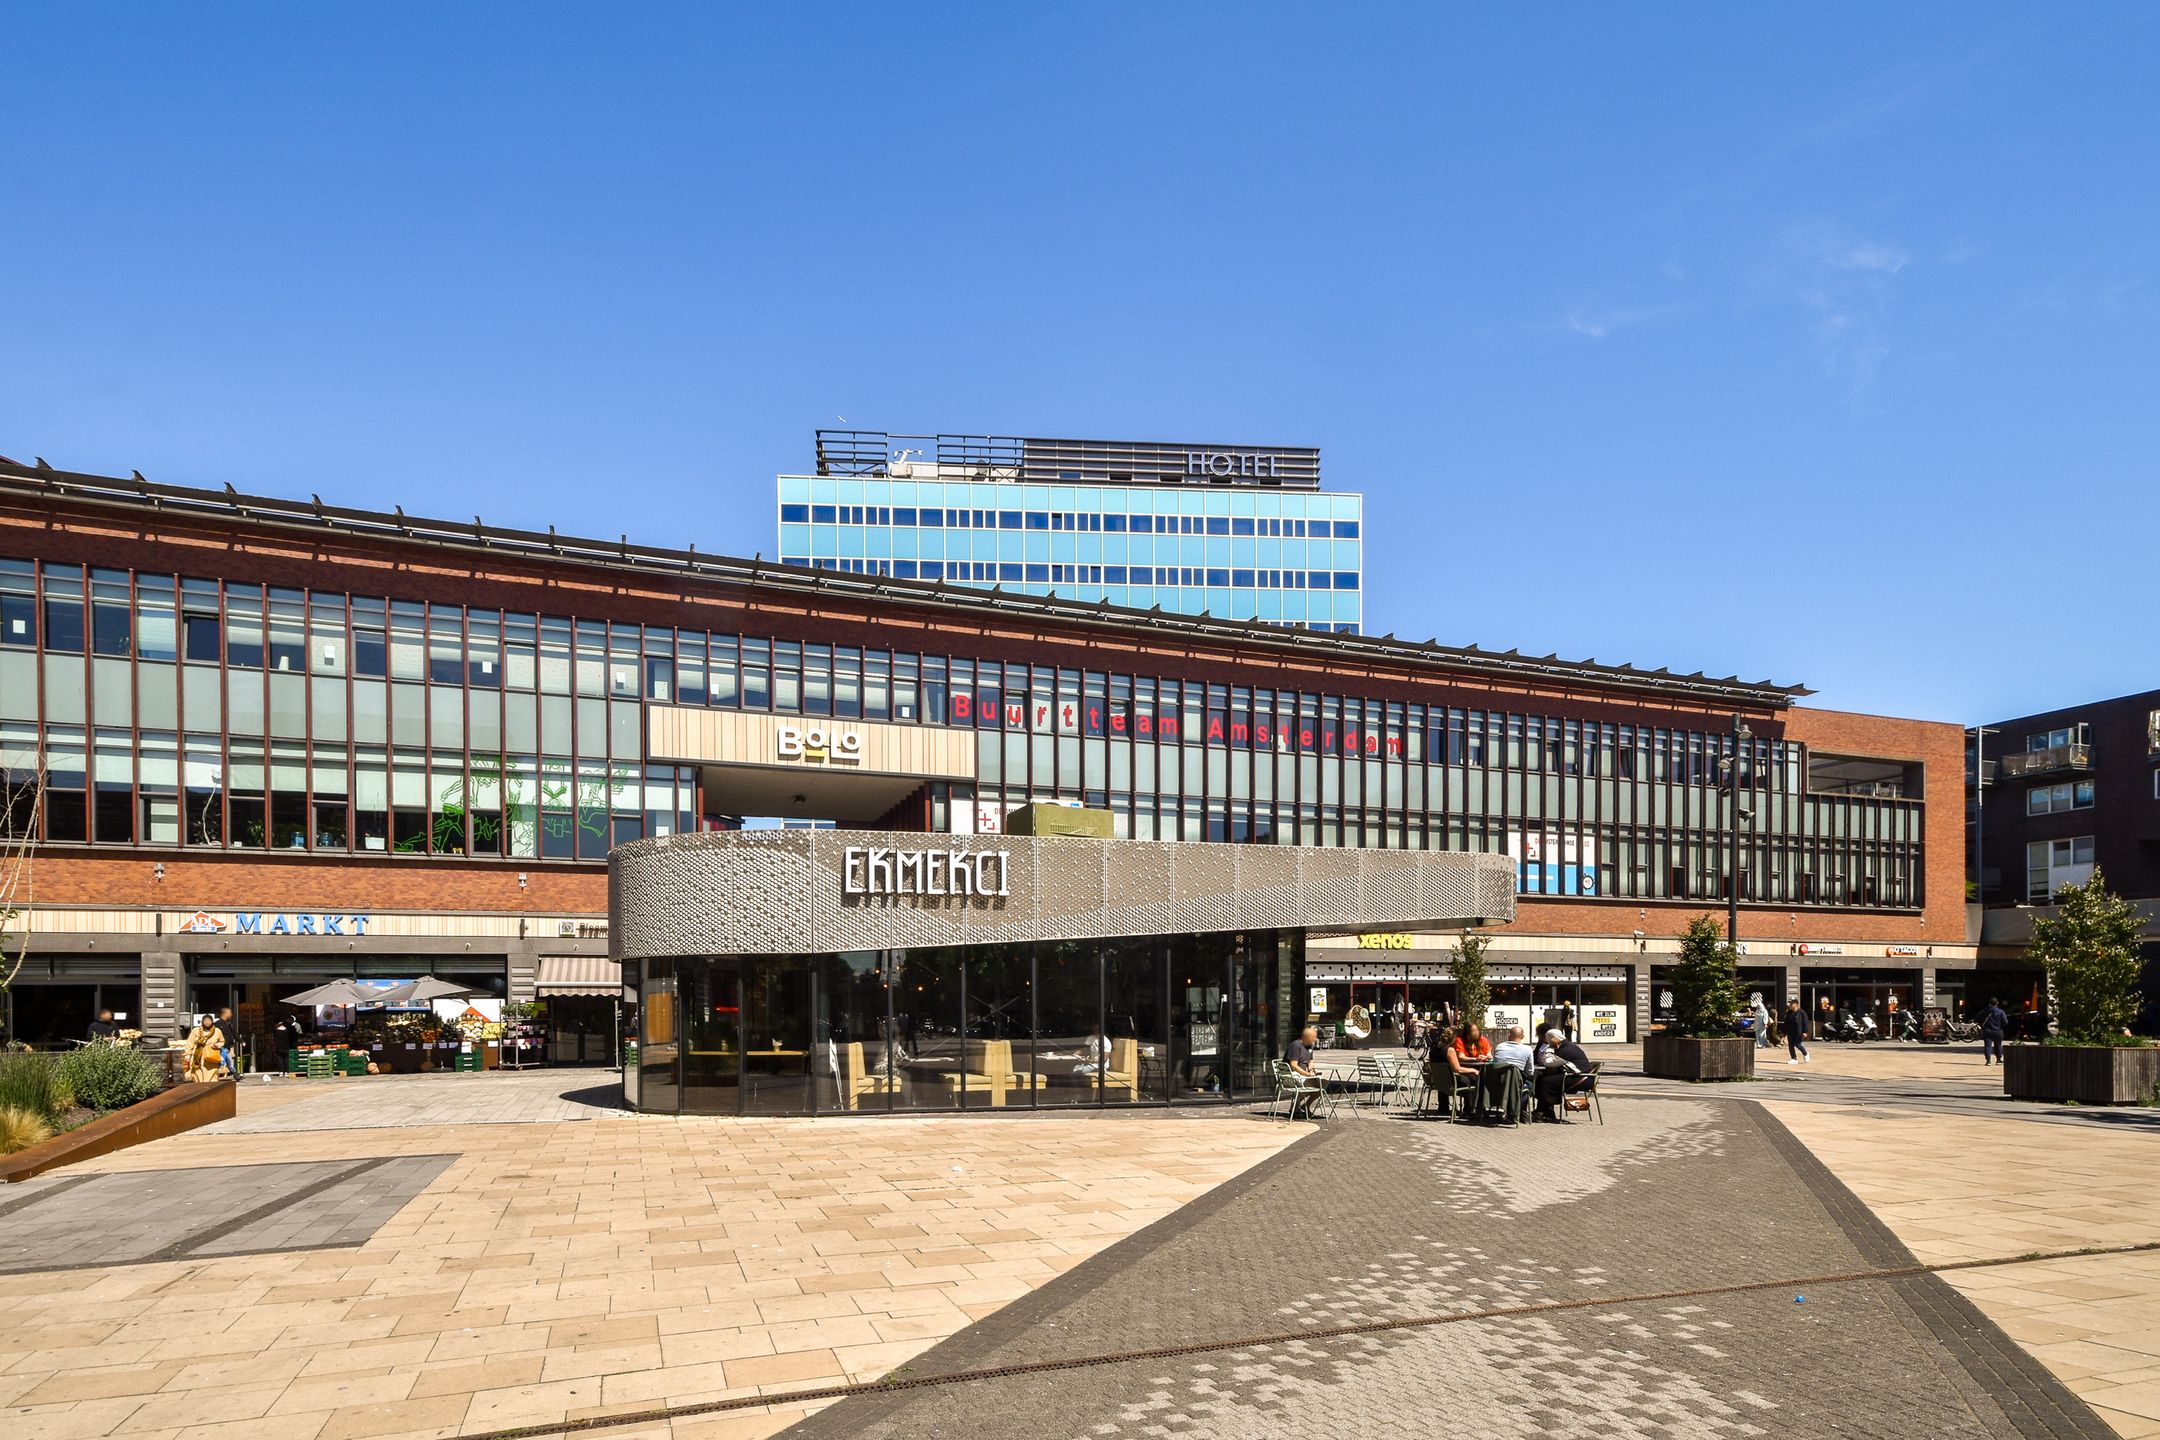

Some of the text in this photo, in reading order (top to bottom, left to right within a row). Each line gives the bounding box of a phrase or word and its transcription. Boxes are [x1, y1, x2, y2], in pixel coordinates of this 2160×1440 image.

[1188, 452, 1281, 476] HOTEL
[955, 694, 1402, 754] Buurtteam Amsterdam
[845, 846, 1010, 896] EKMEKCI
[236, 912, 369, 936] MARKT
[1358, 933, 1414, 950] xenos
